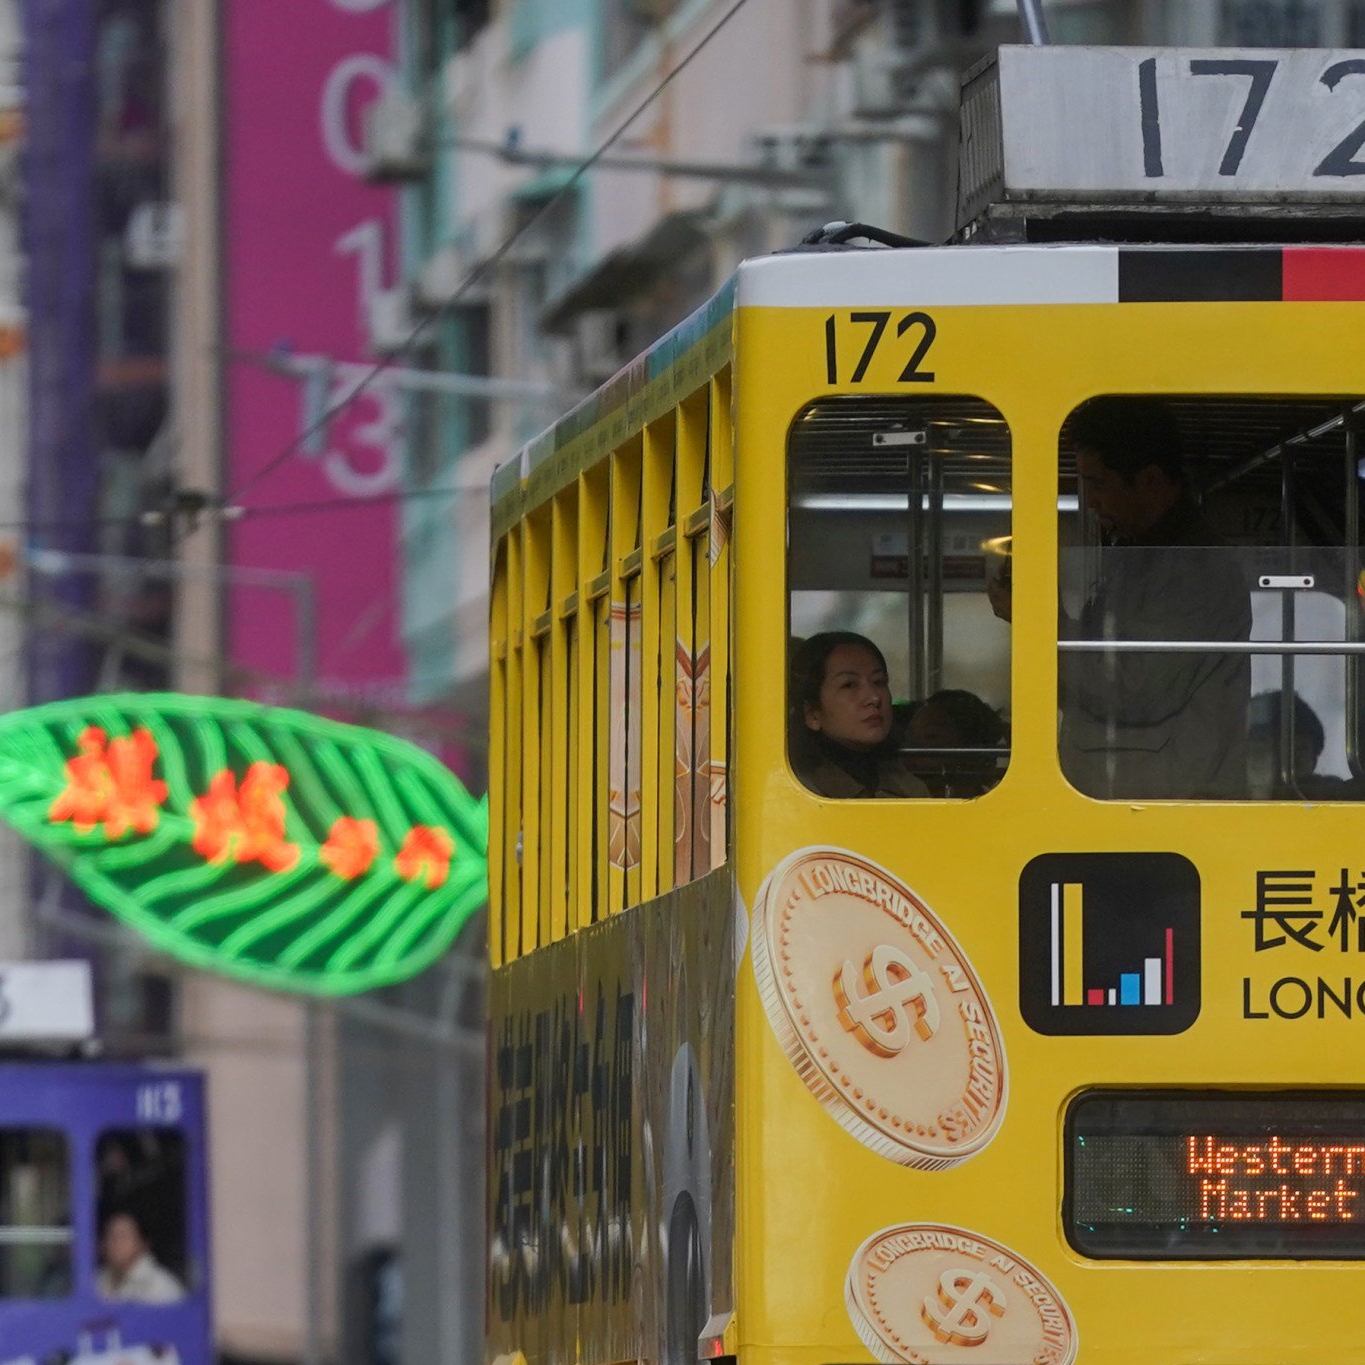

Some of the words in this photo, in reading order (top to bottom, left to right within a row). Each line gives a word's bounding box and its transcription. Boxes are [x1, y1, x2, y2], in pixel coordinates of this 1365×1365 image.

[824, 312, 937, 385] 172
[798, 864, 947, 961] LONGBRIDGE
[939, 963, 969, 993] AI
[138, 1081, 184, 1121] 113
[1200, 1179, 1357, 1218] Market
[868, 1233, 986, 1272] LONGBRIDGE
[989, 1254, 1015, 1274] AI
